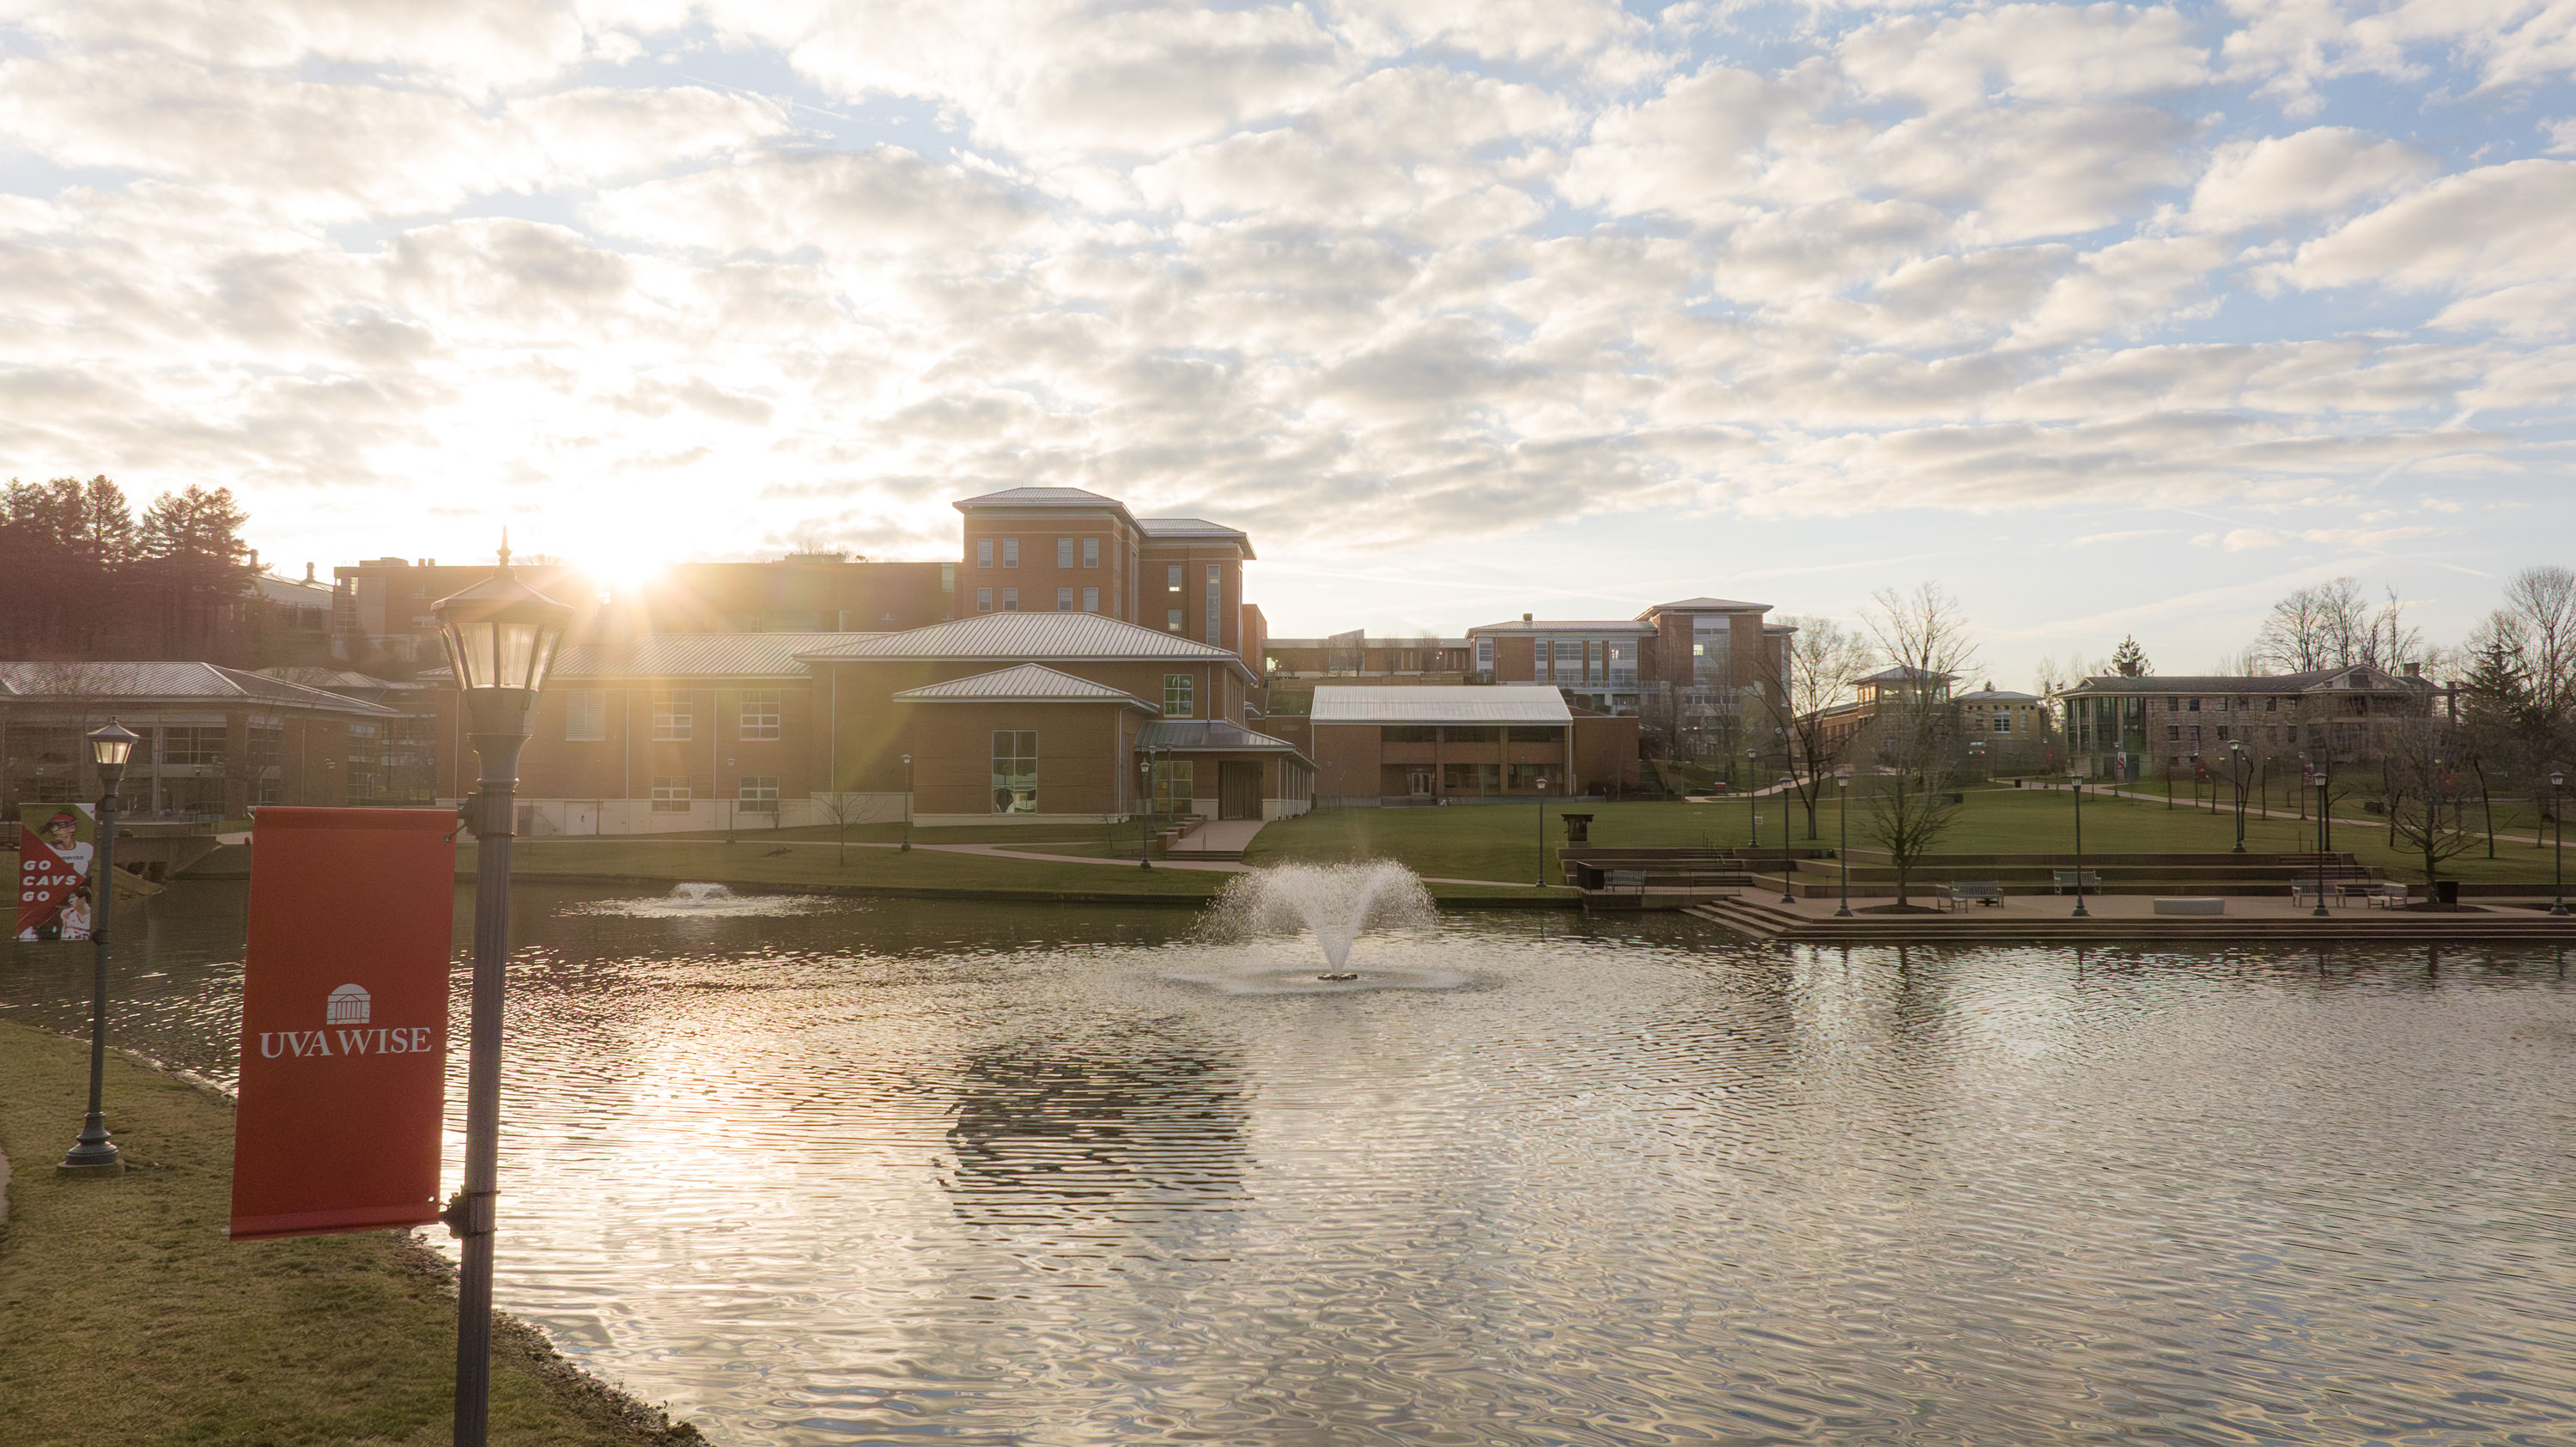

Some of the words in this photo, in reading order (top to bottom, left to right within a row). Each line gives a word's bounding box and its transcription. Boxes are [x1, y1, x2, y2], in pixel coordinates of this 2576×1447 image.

[23, 860, 52, 871] GO
[22, 875, 76, 886] CAVS
[21, 891, 50, 902] GO
[259, 1030, 333, 1058] UVA
[336, 1027, 432, 1055] WISE
